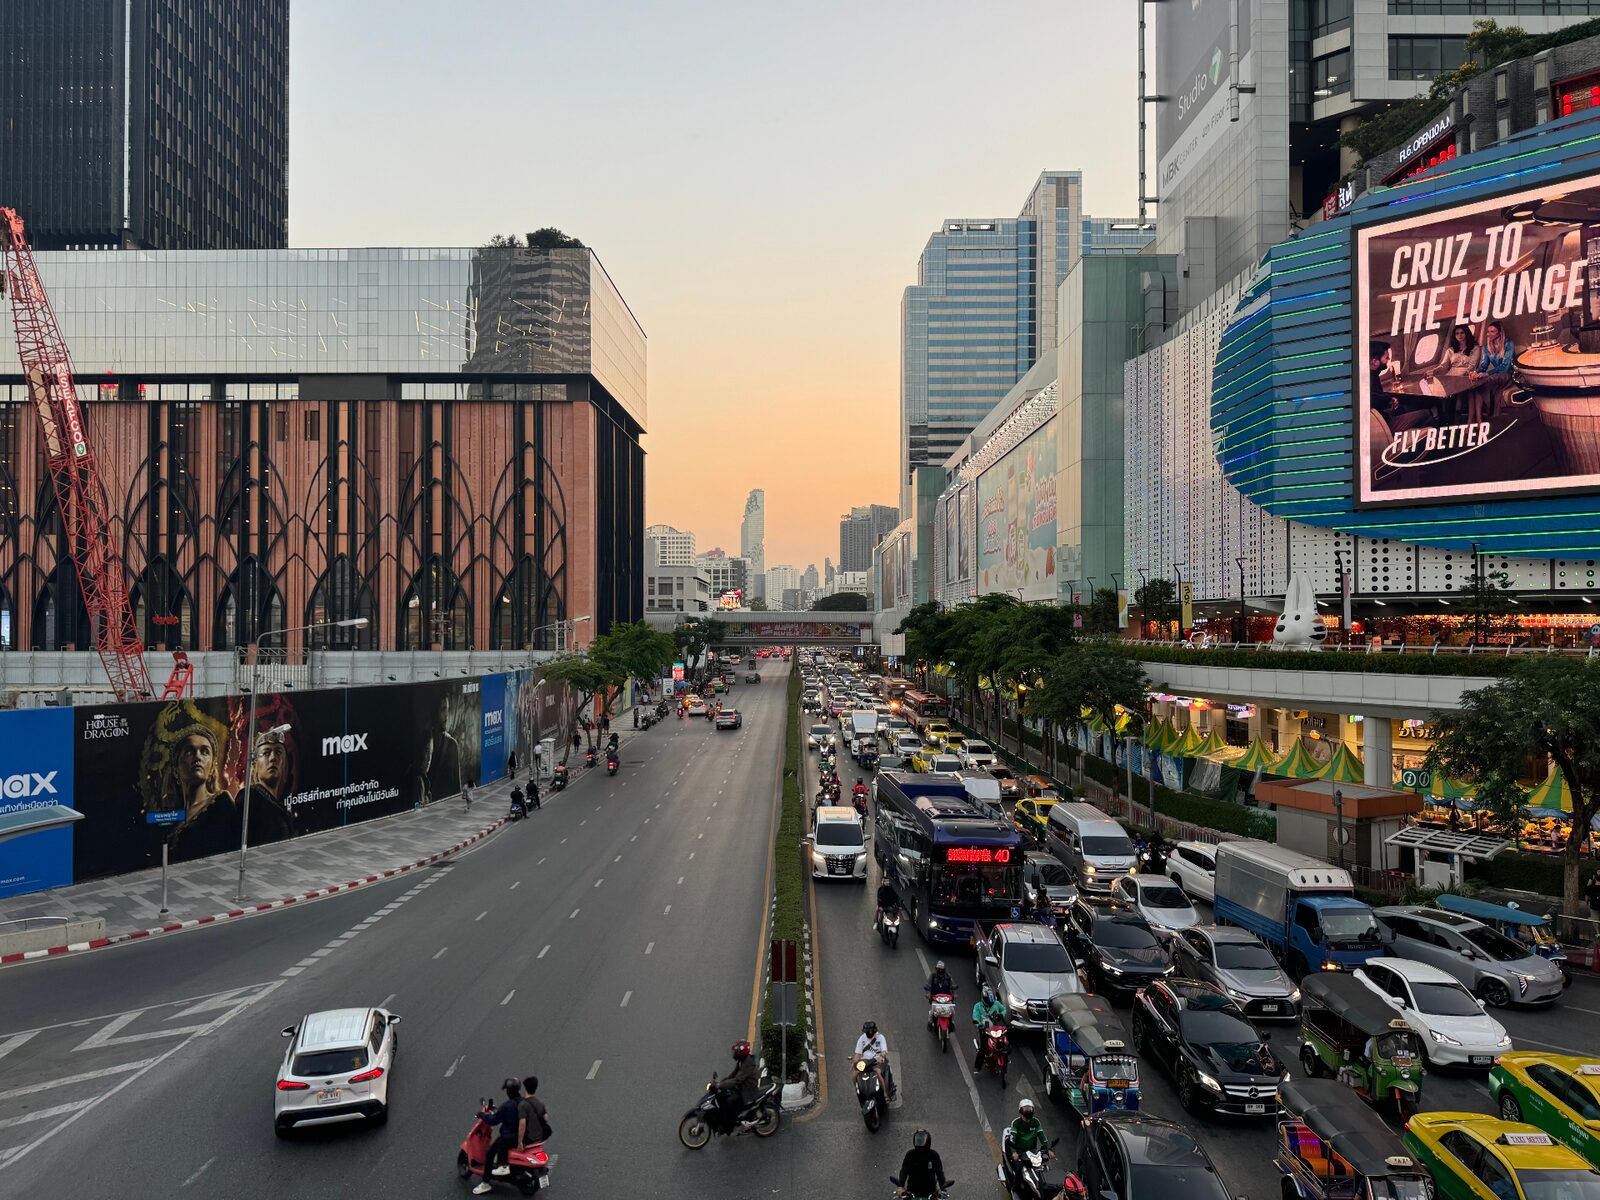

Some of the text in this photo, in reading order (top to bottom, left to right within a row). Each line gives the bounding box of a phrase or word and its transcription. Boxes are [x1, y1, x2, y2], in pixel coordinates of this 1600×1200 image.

[1177, 73, 1207, 120] Studio
[1162, 154, 1180, 189] MBK
[1390, 221, 1525, 290] CRUZ TO
[1390, 258, 1589, 337] THE LOUNGE
[60, 377, 82, 442] SEAFCO
[1392, 421, 1491, 455] FLY BETTER
[86, 719, 119, 730] HOUSE
[484, 709, 503, 727] max
[84, 727, 129, 740] DRAGON
[322, 732, 368, 757] max
[0, 770, 58, 800] ax
[994, 849, 1010, 862] 40
[1510, 1135, 1550, 1144] TAXI METER
